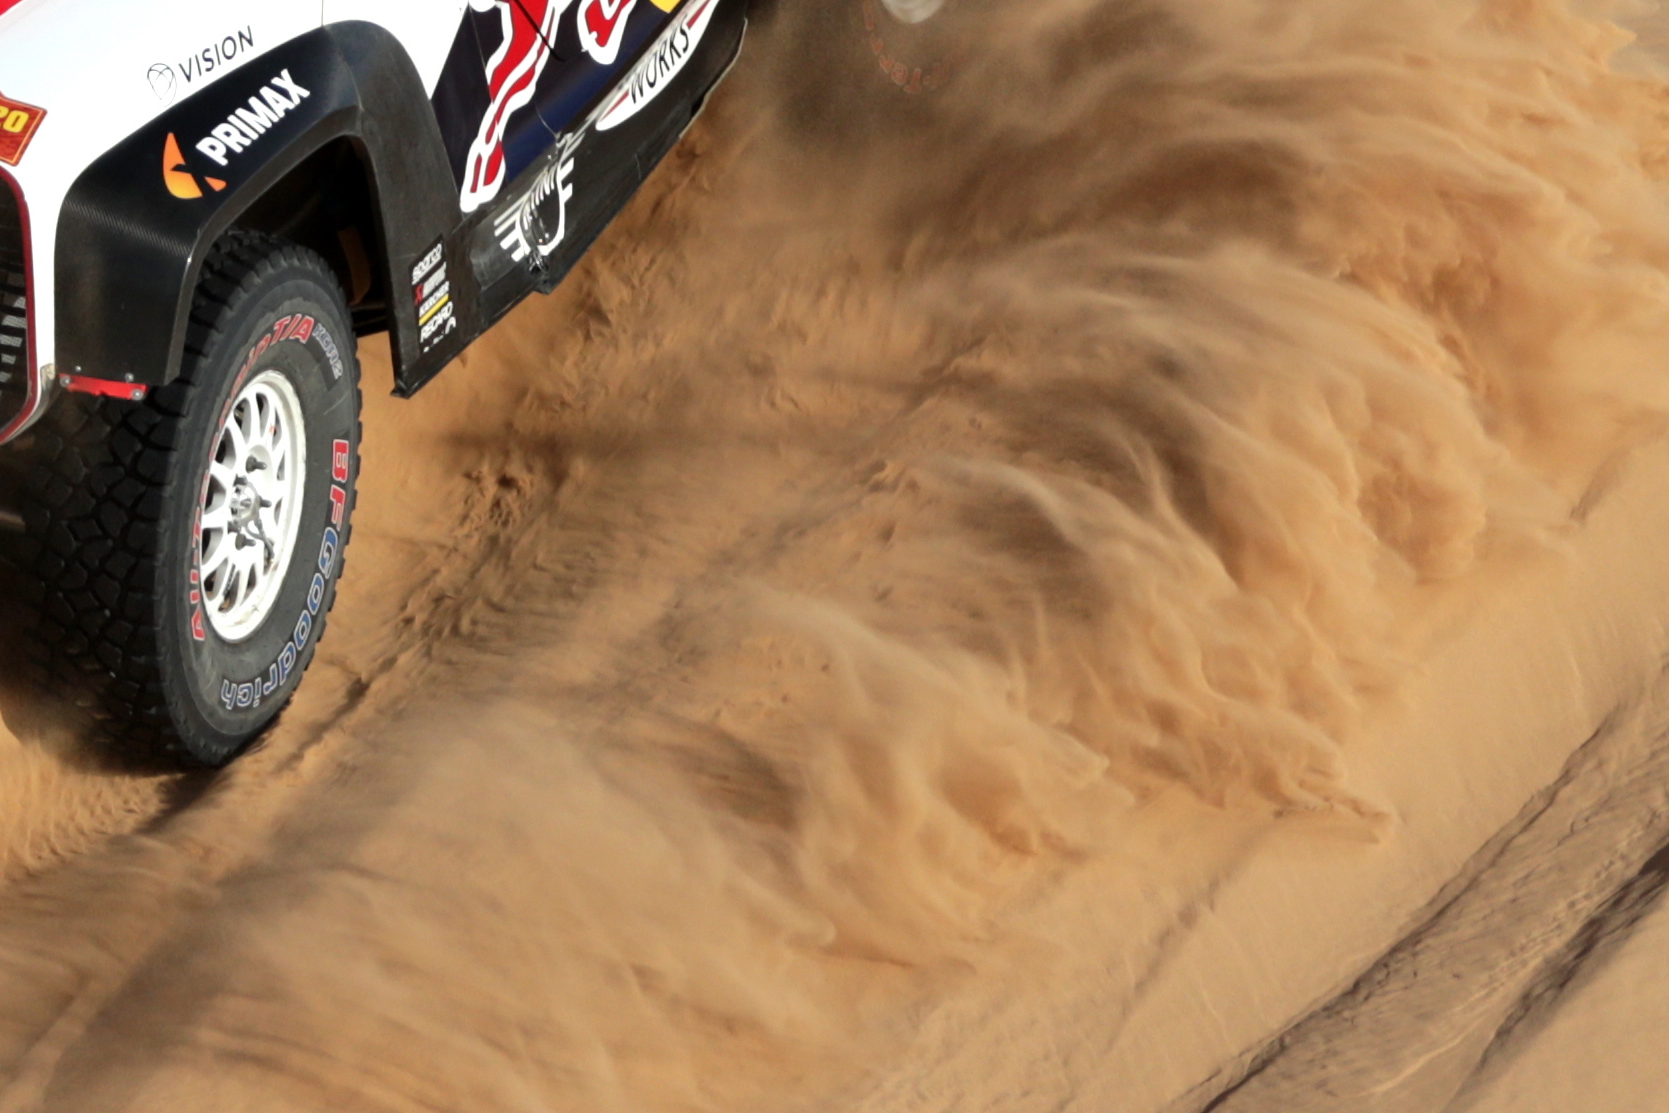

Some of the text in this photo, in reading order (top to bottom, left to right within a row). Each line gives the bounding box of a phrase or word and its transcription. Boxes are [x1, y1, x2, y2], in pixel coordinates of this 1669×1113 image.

[178, 25, 254, 83] VISION
[631, 13, 690, 105] WORKS
[195, 68, 311, 167] PRIMAX
[271, 314, 315, 346] T/A
[220, 439, 351, 710] BFGoodrich
